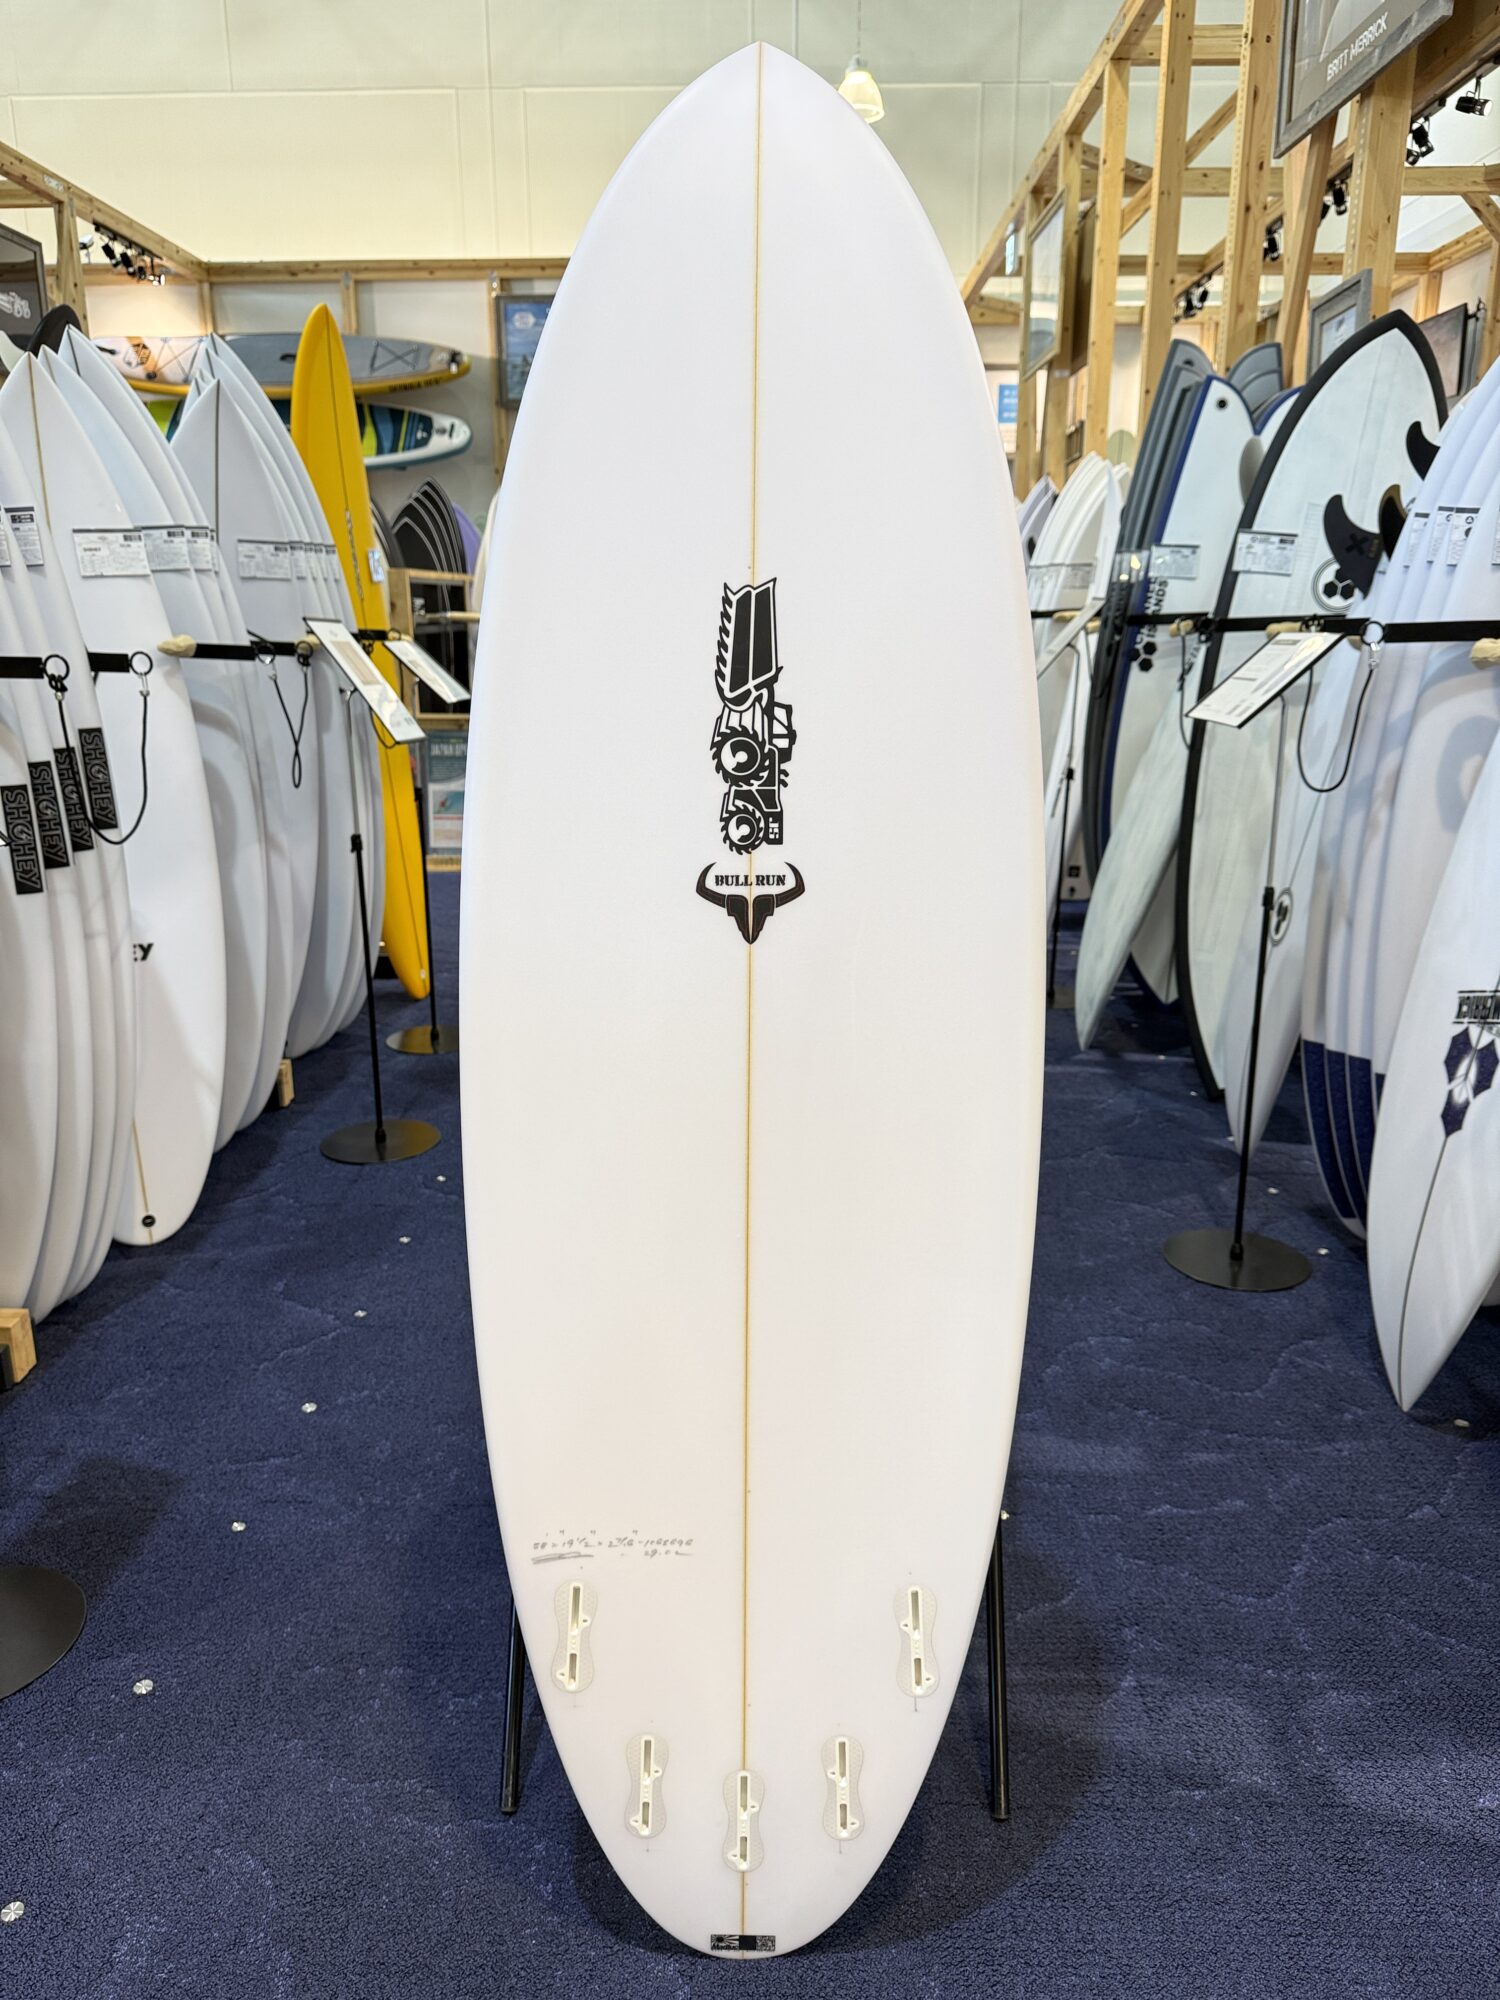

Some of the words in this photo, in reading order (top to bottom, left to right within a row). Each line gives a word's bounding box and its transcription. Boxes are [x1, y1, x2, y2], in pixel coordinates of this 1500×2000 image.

[1327, 49, 1349, 81] BRITT
[1350, 11, 1388, 60] MERRICK
[1146, 579, 1168, 638] ISANDS
[30, 765, 67, 864] SHOHEY
[81, 731, 116, 825] SHOHEY
[3, 790, 41, 889] SHOHEY
[714, 874, 753, 887] BULL
[755, 874, 787, 887] RUN
